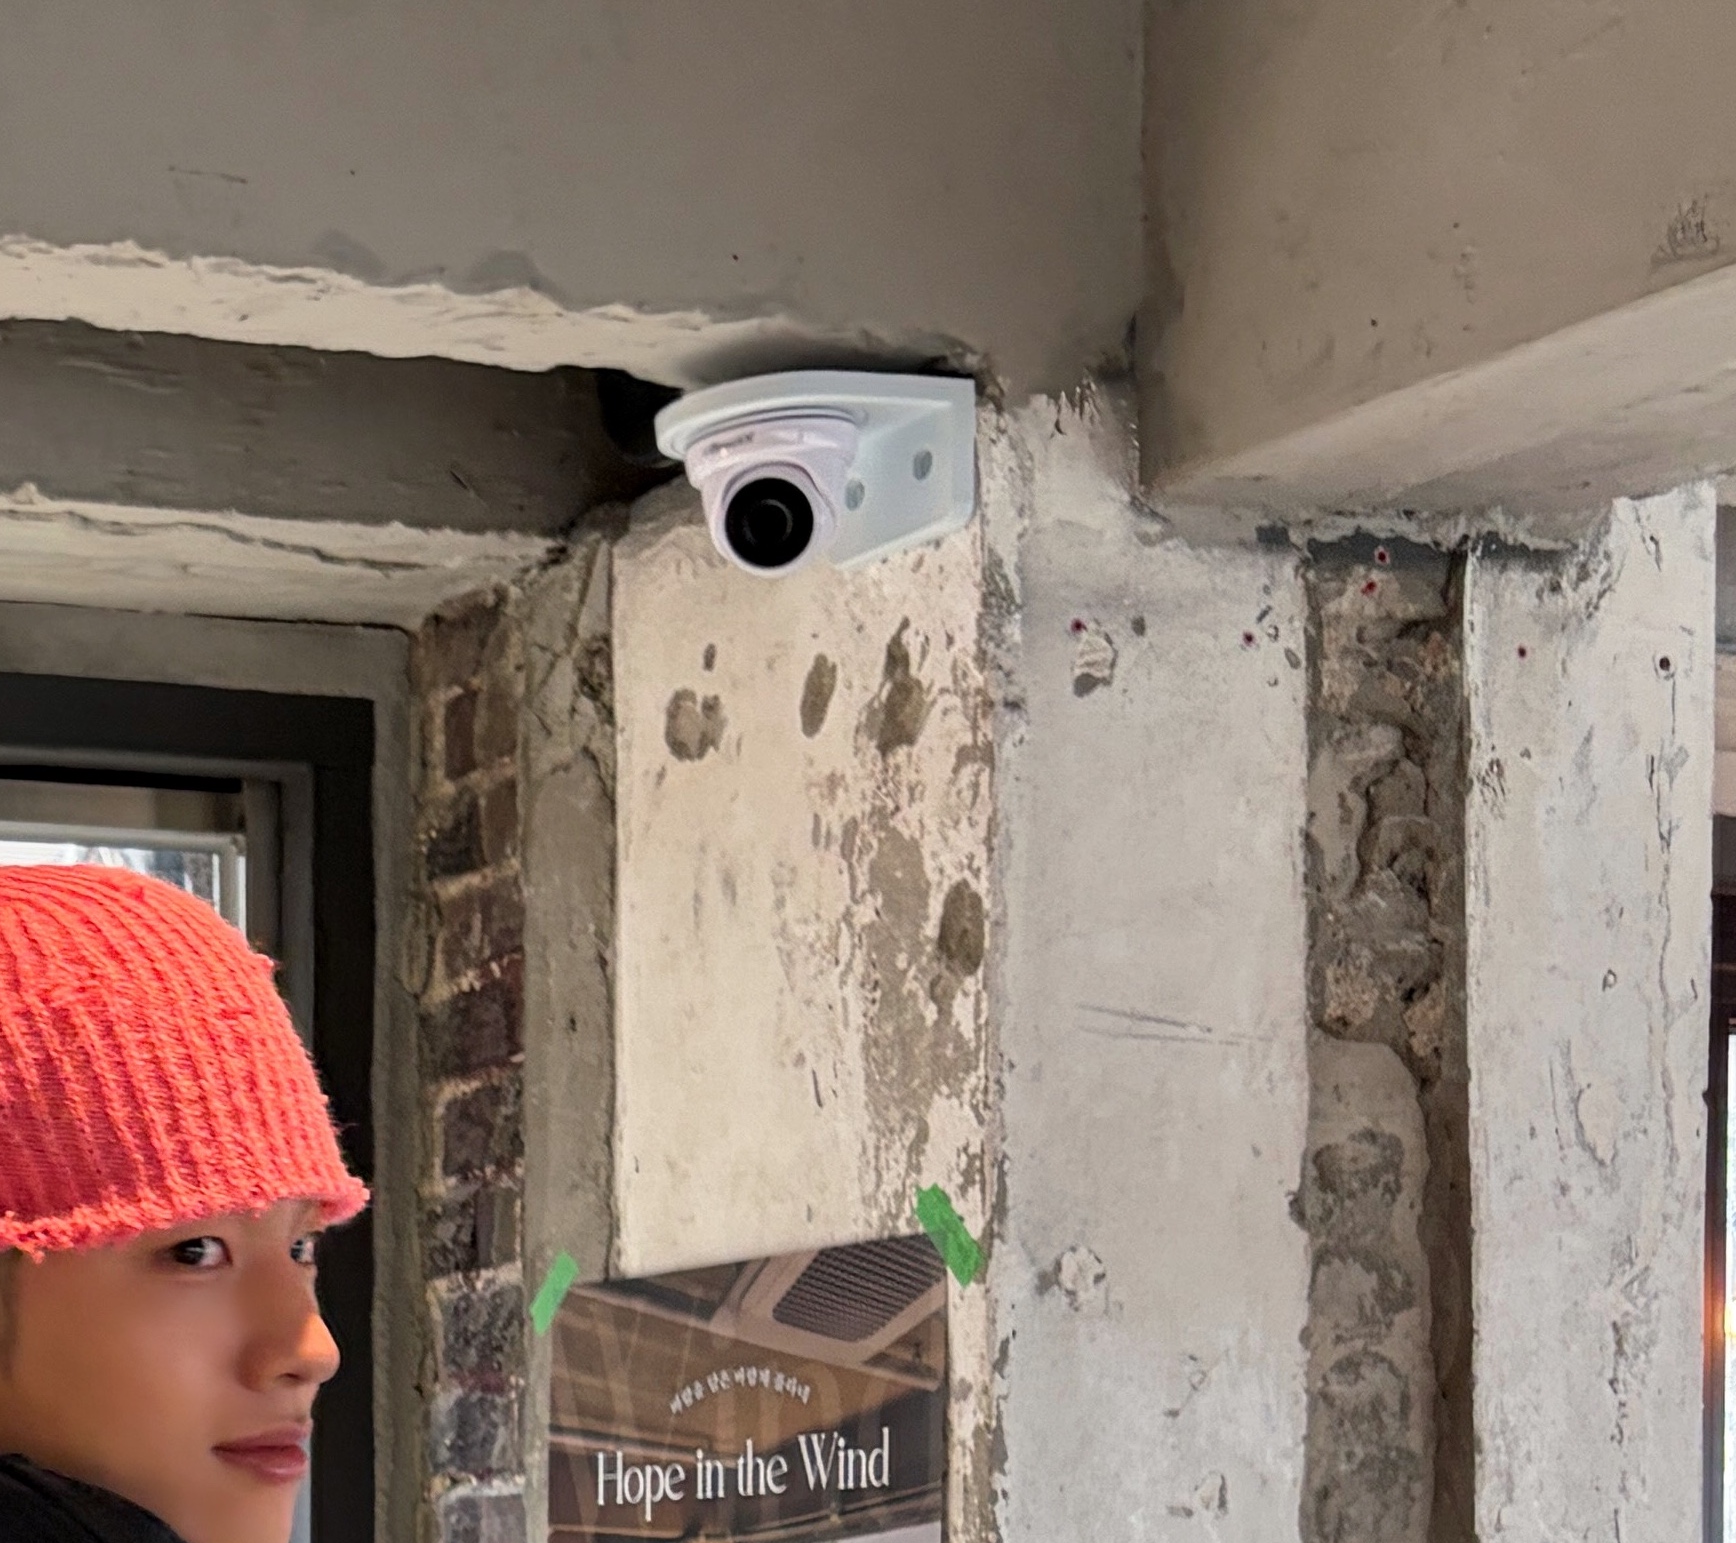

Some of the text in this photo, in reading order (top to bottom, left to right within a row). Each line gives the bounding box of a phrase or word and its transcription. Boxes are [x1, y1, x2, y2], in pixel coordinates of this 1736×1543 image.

[596, 1426, 891, 1523] Hope in the Wind
